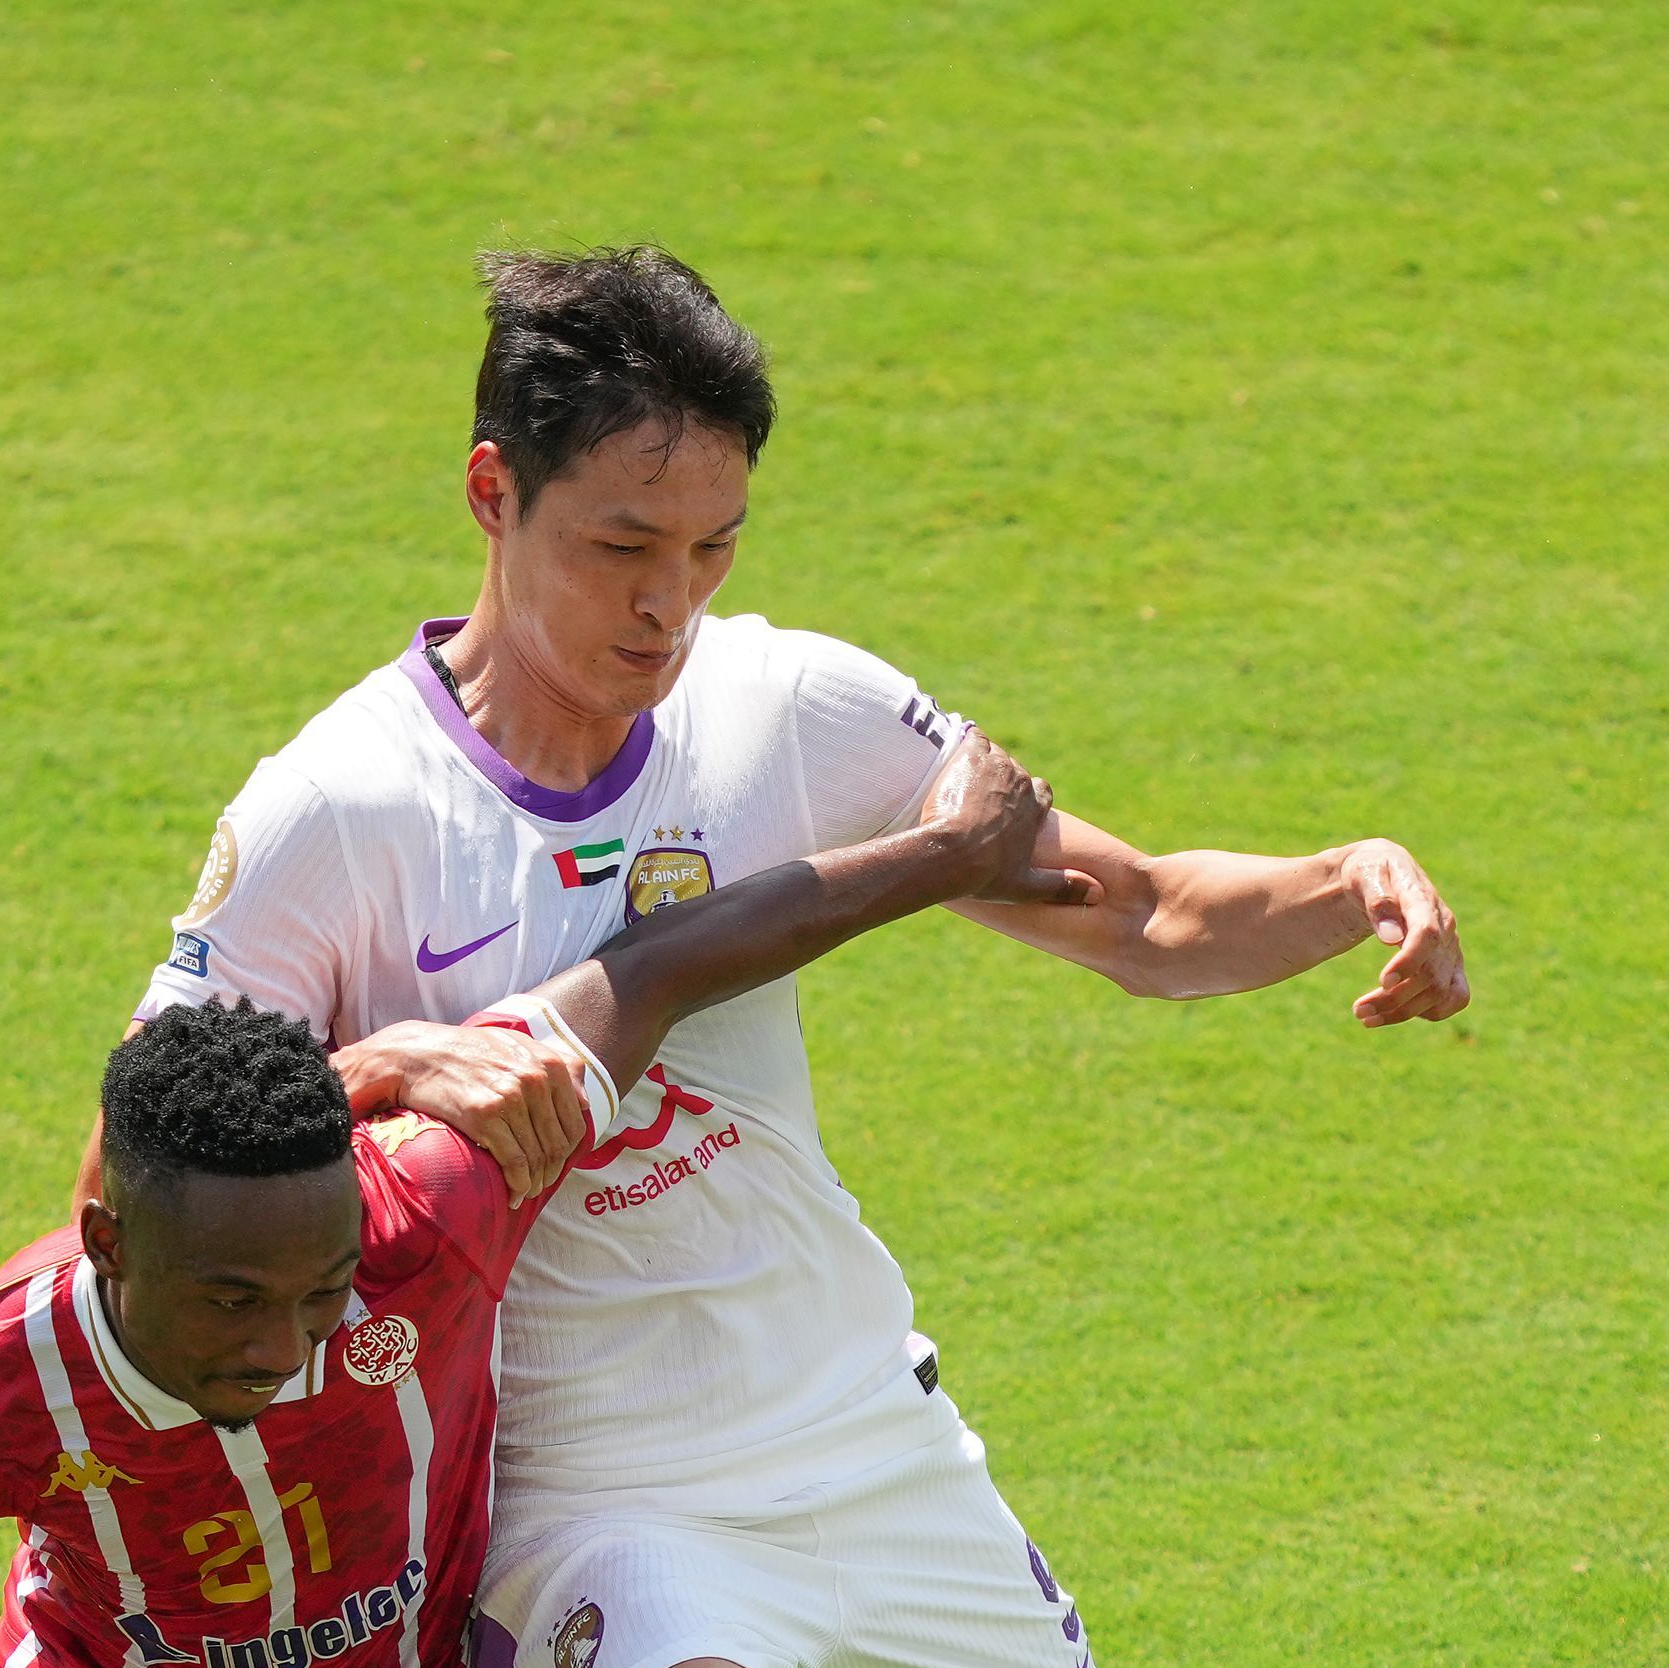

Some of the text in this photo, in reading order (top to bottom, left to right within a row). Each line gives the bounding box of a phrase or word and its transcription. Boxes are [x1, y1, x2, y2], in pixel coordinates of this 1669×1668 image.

[638, 867, 701, 884] AL AIN FC
[179, 956, 198, 968] FIFA
[584, 1122, 741, 1216] etisalat and
[183, 1482, 332, 1604] 21
[564, 1626, 578, 1649] AIN
[576, 1612, 591, 1630] FC
